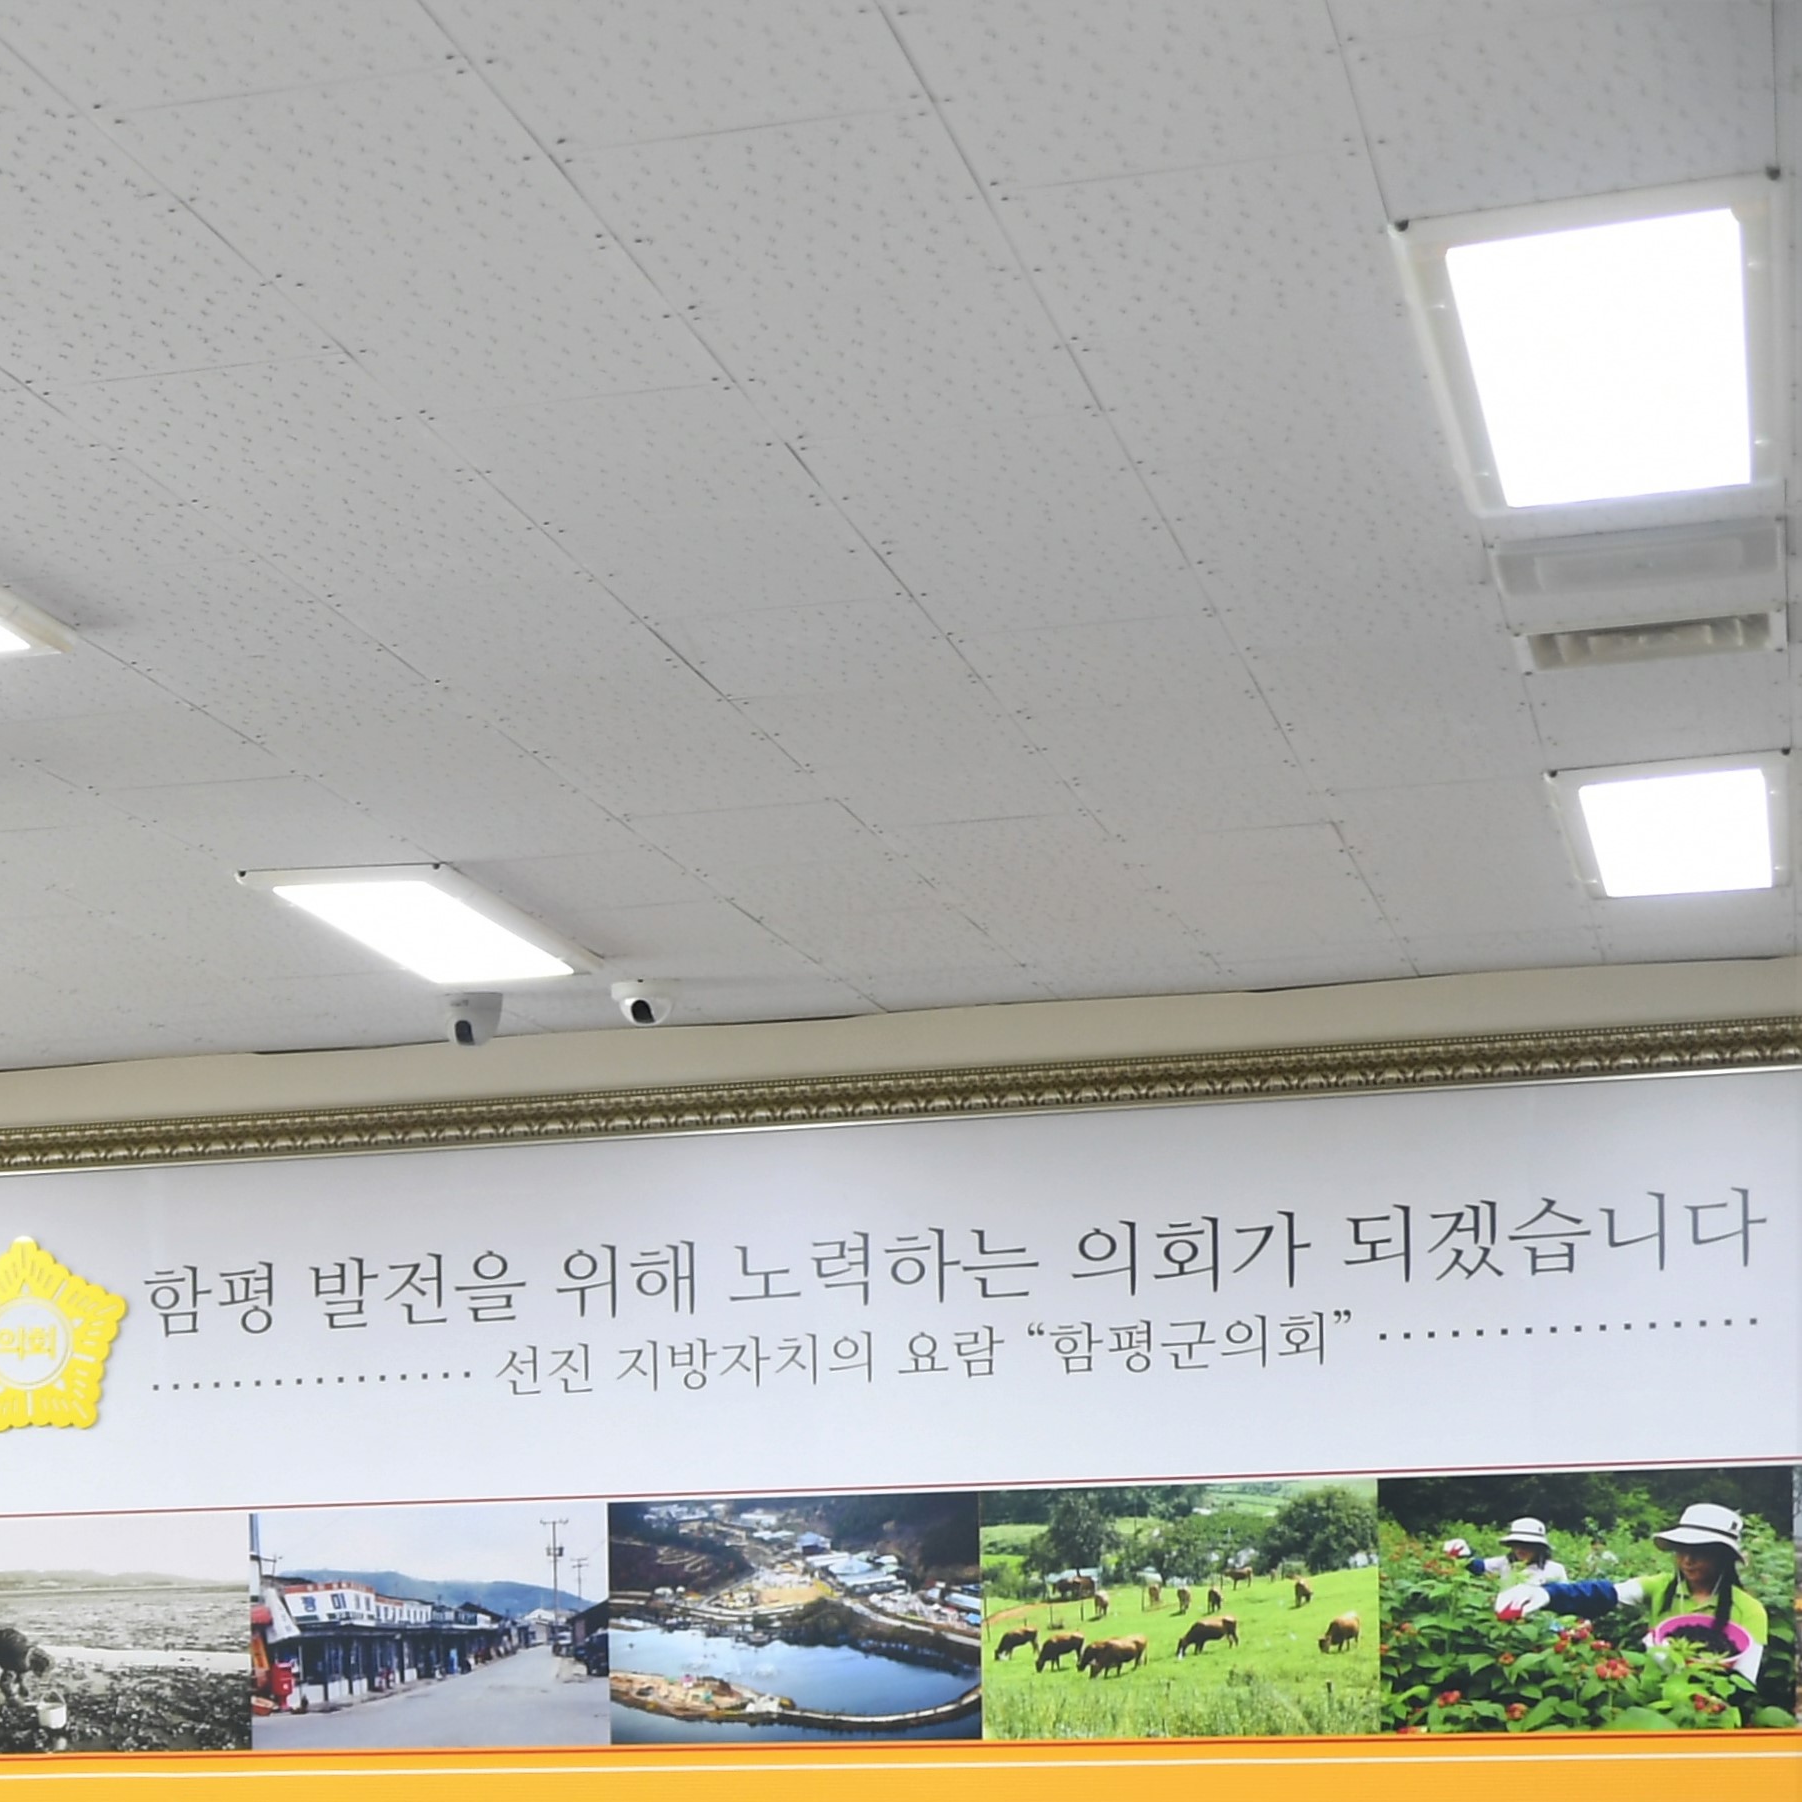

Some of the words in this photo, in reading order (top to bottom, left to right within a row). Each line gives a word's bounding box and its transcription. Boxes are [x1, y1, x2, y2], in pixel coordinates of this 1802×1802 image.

[143, 1260, 274, 1338] 함평
[308, 1249, 527, 1330] 발전을
[555, 1239, 696, 1319] 위해
[728, 1226, 1040, 1308] 노력하는
[1071, 1210, 1312, 1297] 의회가
[1343, 1186, 1768, 1284] 되겠습니다
[495, 1342, 594, 1396] 선진
[616, 1330, 873, 1392] 지방자치의
[897, 1324, 1005, 1379] 요람
